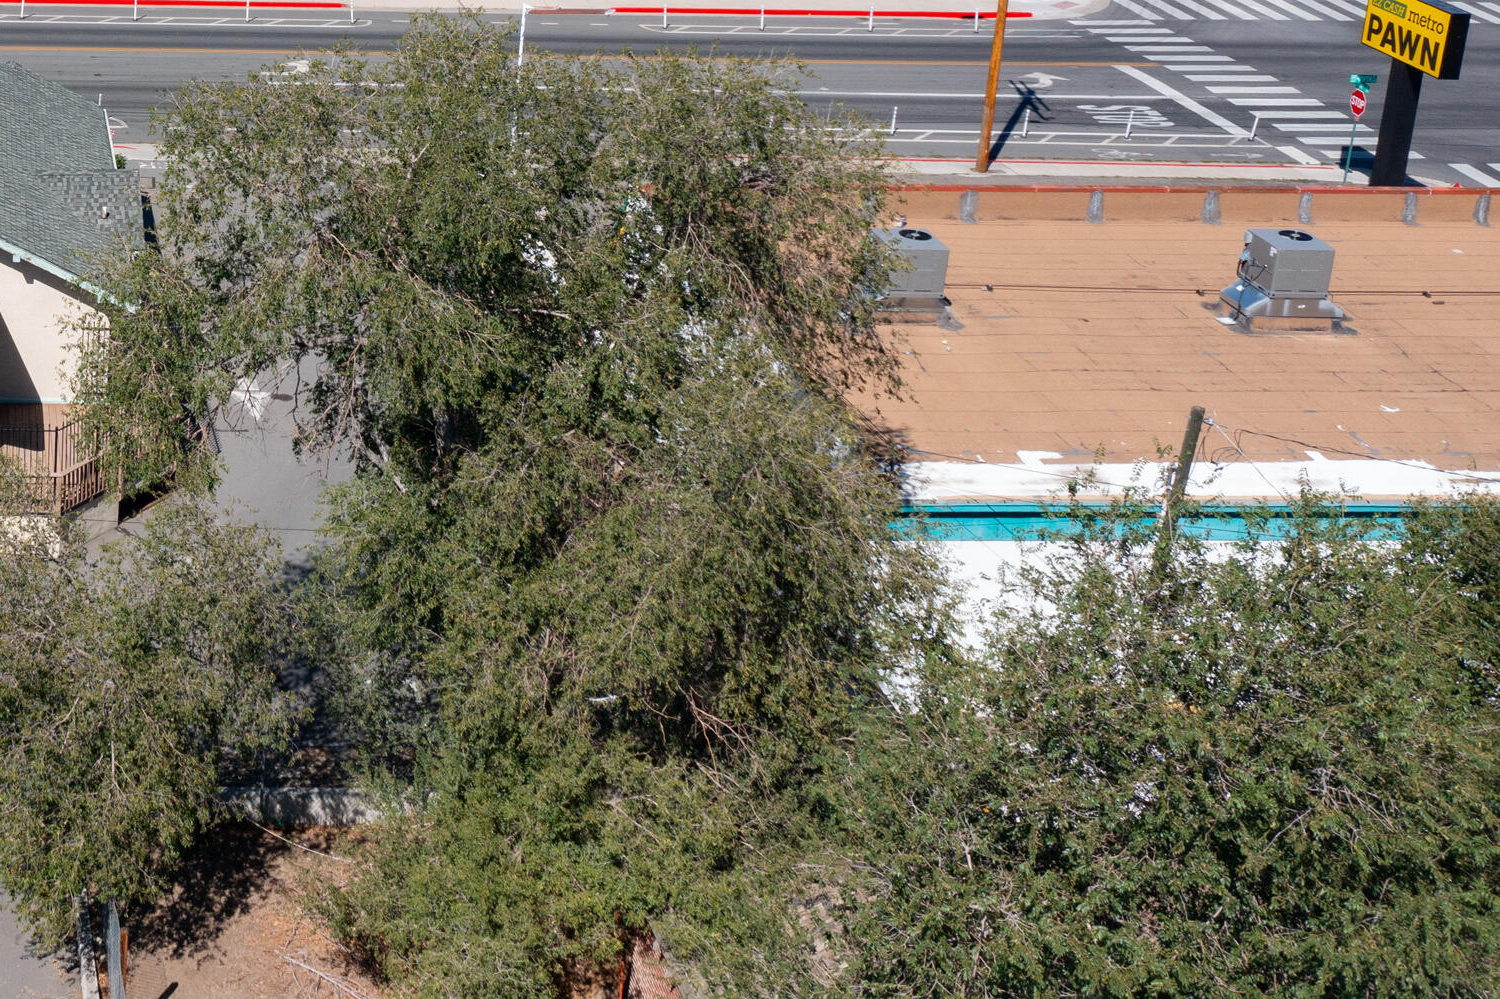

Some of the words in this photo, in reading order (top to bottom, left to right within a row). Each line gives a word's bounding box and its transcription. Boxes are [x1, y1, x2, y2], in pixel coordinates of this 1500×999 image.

[1383, 0, 1405, 17] CASH
[1408, 10, 1444, 34] metro
[1367, 13, 1440, 72] PAWN
[1076, 104, 1176, 128] STOP
[1351, 95, 1365, 108] STOP
